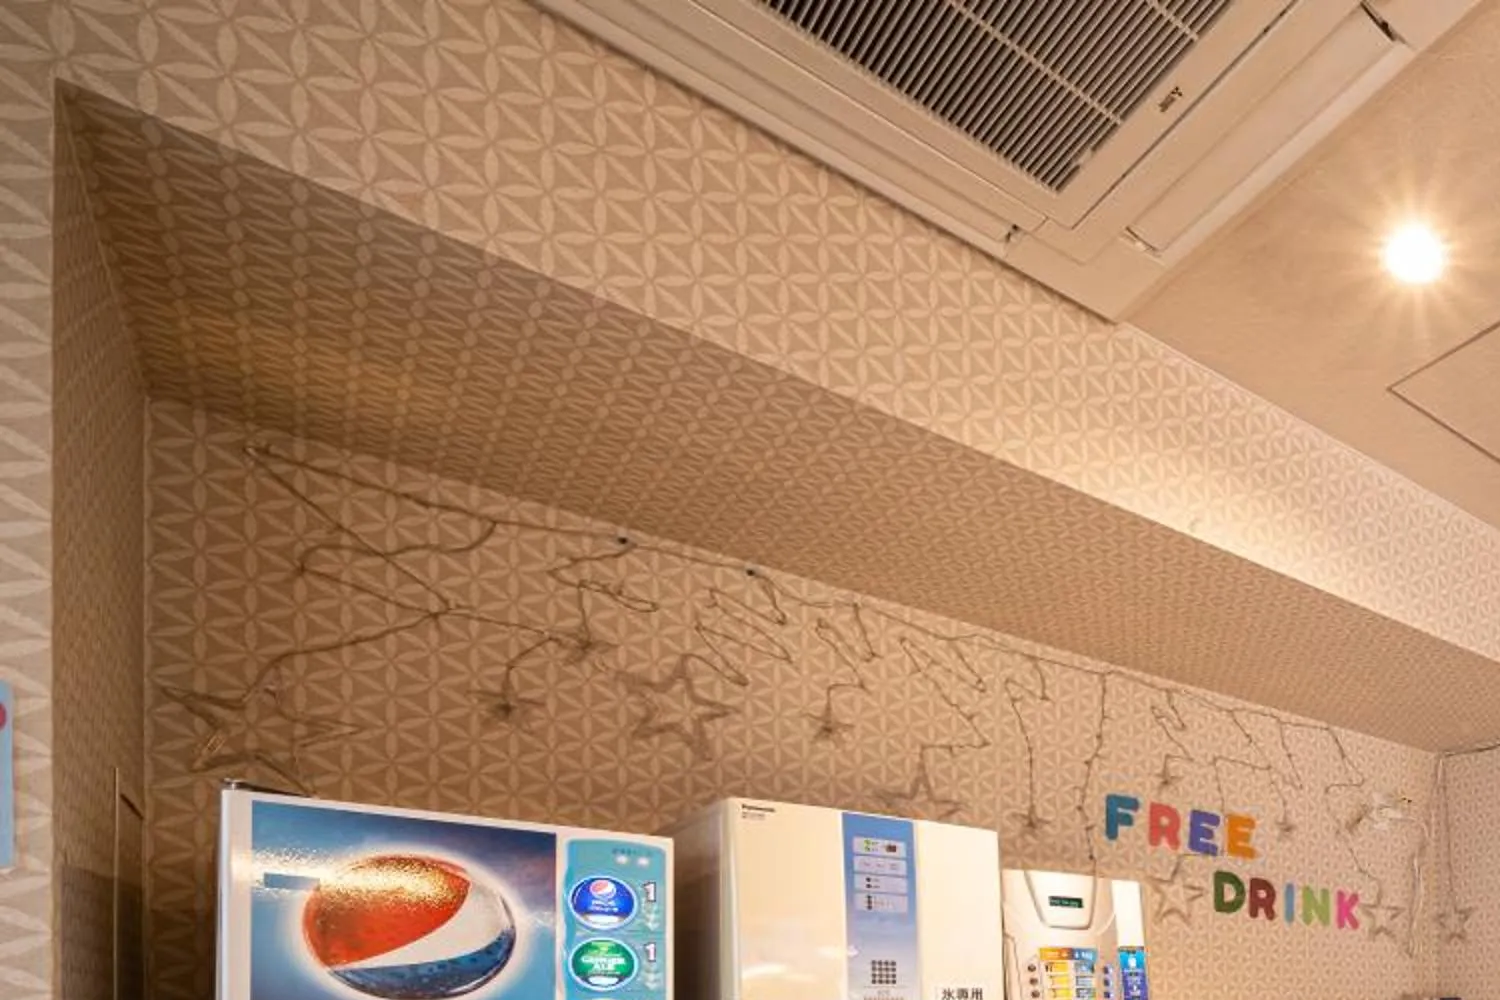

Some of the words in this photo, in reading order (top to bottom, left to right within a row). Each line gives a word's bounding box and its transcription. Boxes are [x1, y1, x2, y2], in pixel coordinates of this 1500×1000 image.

[1104, 793, 1258, 860] FREE
[644, 882, 657, 903] 1
[1213, 870, 1361, 930] DRINK
[644, 942, 657, 963] 1
